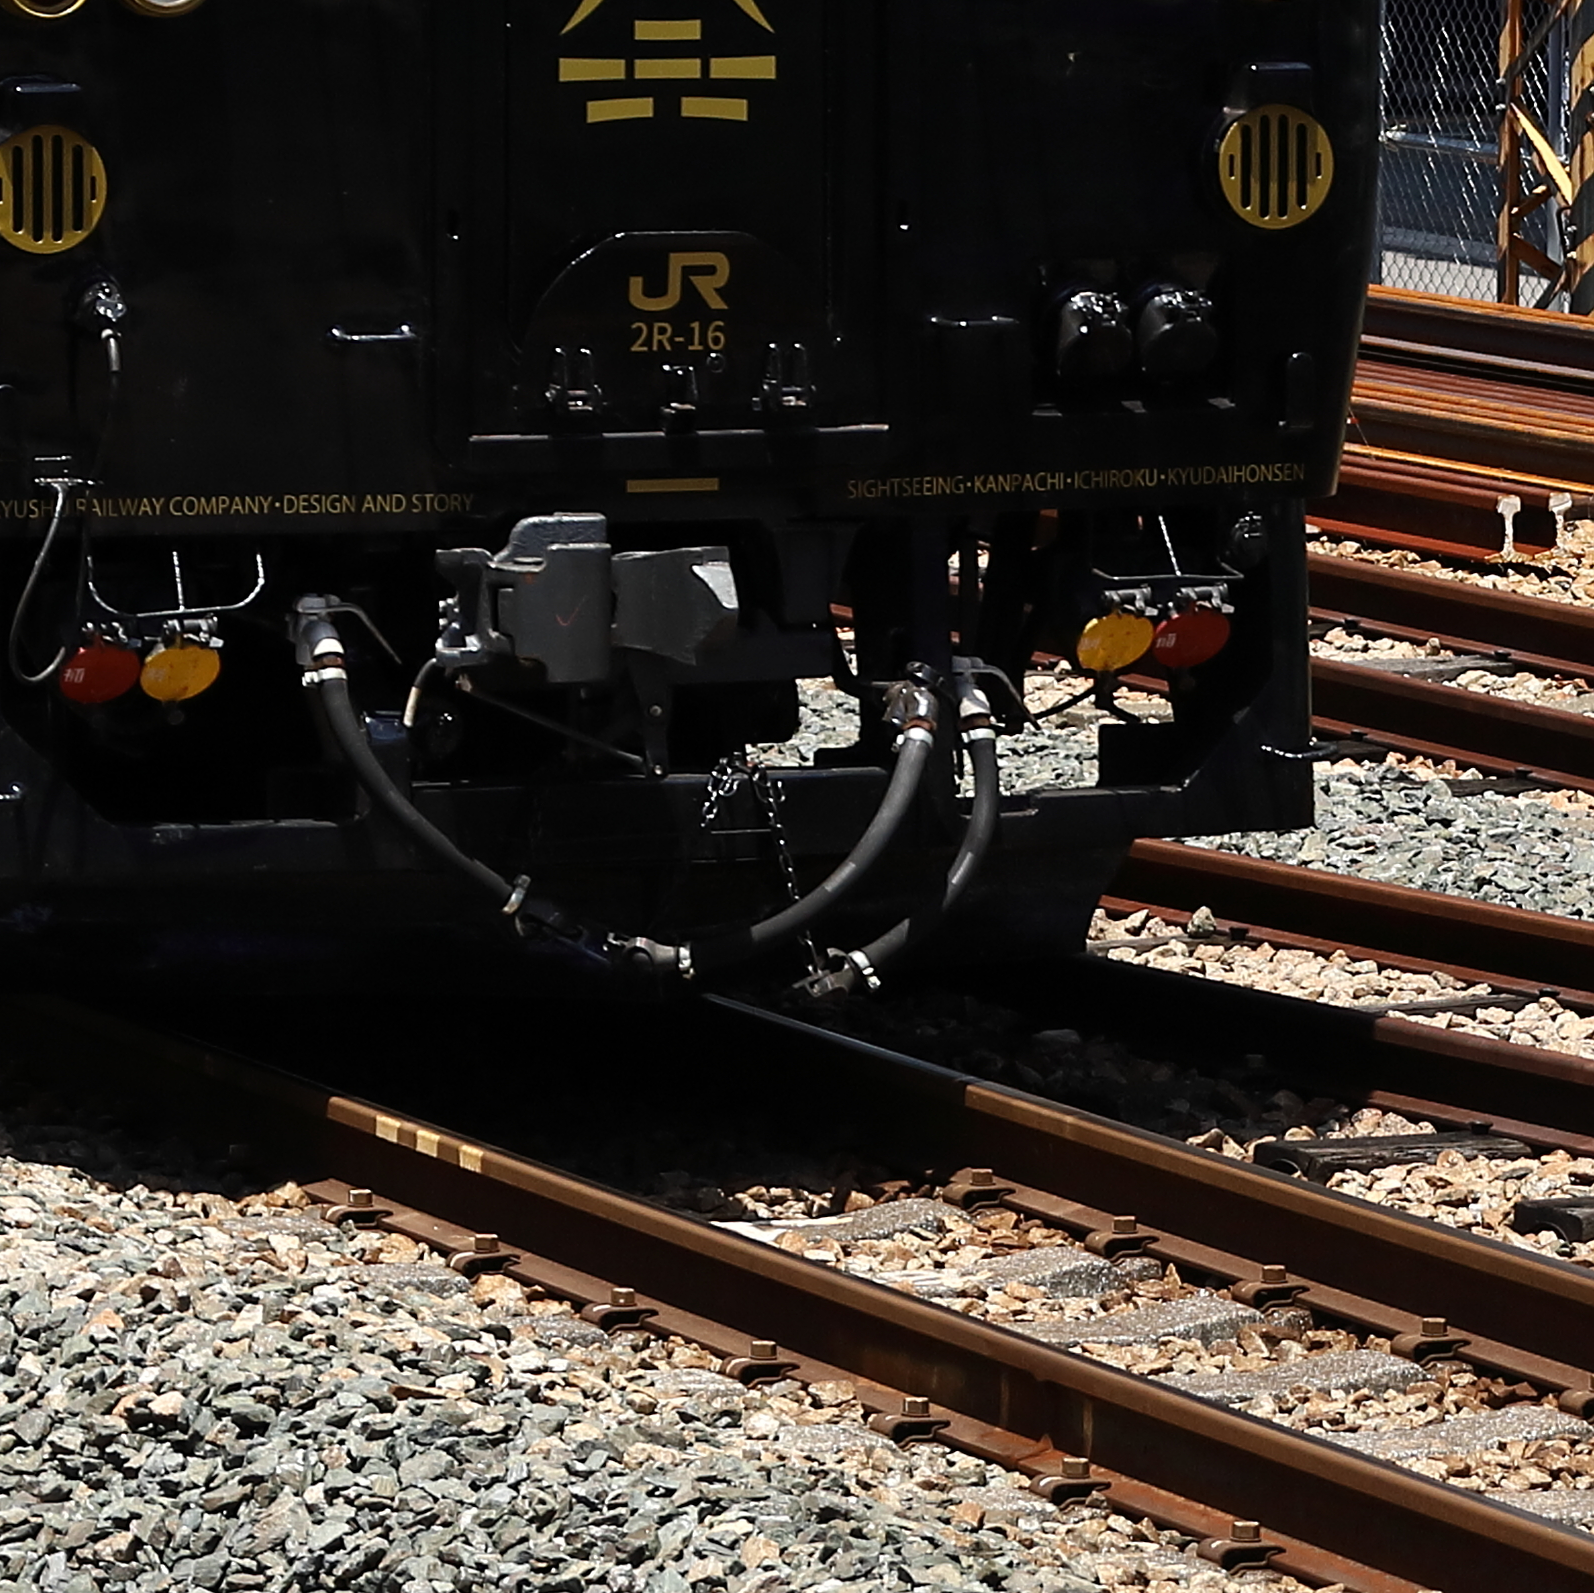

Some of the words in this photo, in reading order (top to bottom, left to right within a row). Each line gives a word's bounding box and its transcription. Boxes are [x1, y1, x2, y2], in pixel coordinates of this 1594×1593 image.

[628, 251, 731, 311] JR
[629, 320, 727, 352] 2R-16
[361, 494, 407, 514] AND
[411, 493, 474, 513] STORY
